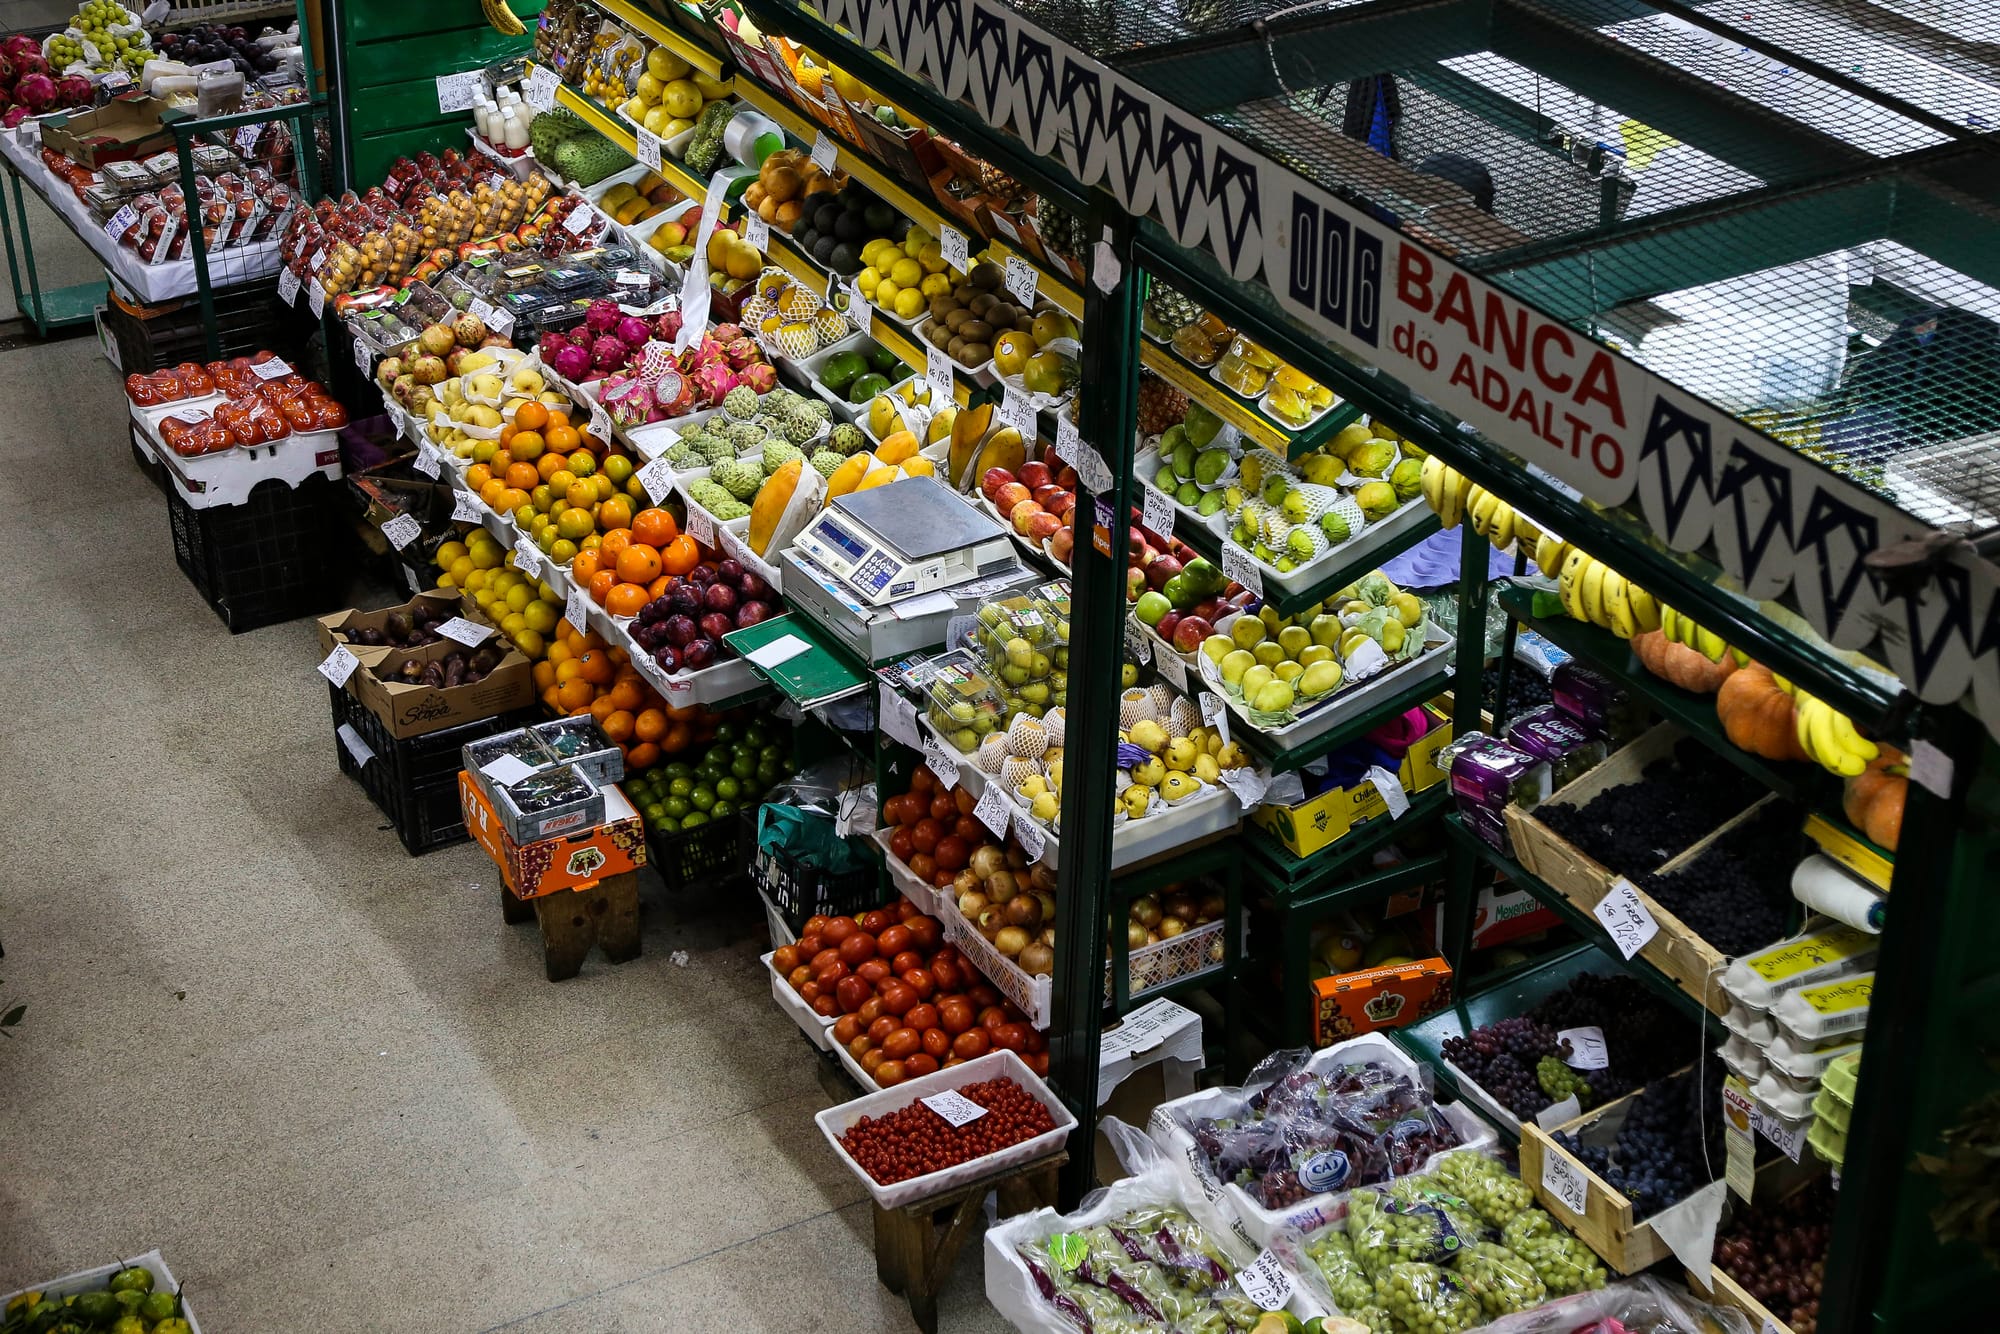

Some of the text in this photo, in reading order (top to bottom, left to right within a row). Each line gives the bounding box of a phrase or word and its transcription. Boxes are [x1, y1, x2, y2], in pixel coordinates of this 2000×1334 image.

[1296, 211, 1376, 329] 006
[1397, 240, 1627, 430] BANCA
[1392, 321, 1625, 480] do ADALTO
[1723, 1088, 1753, 1114] SAÚDE
[1311, 1159, 1339, 1175] CAJ
